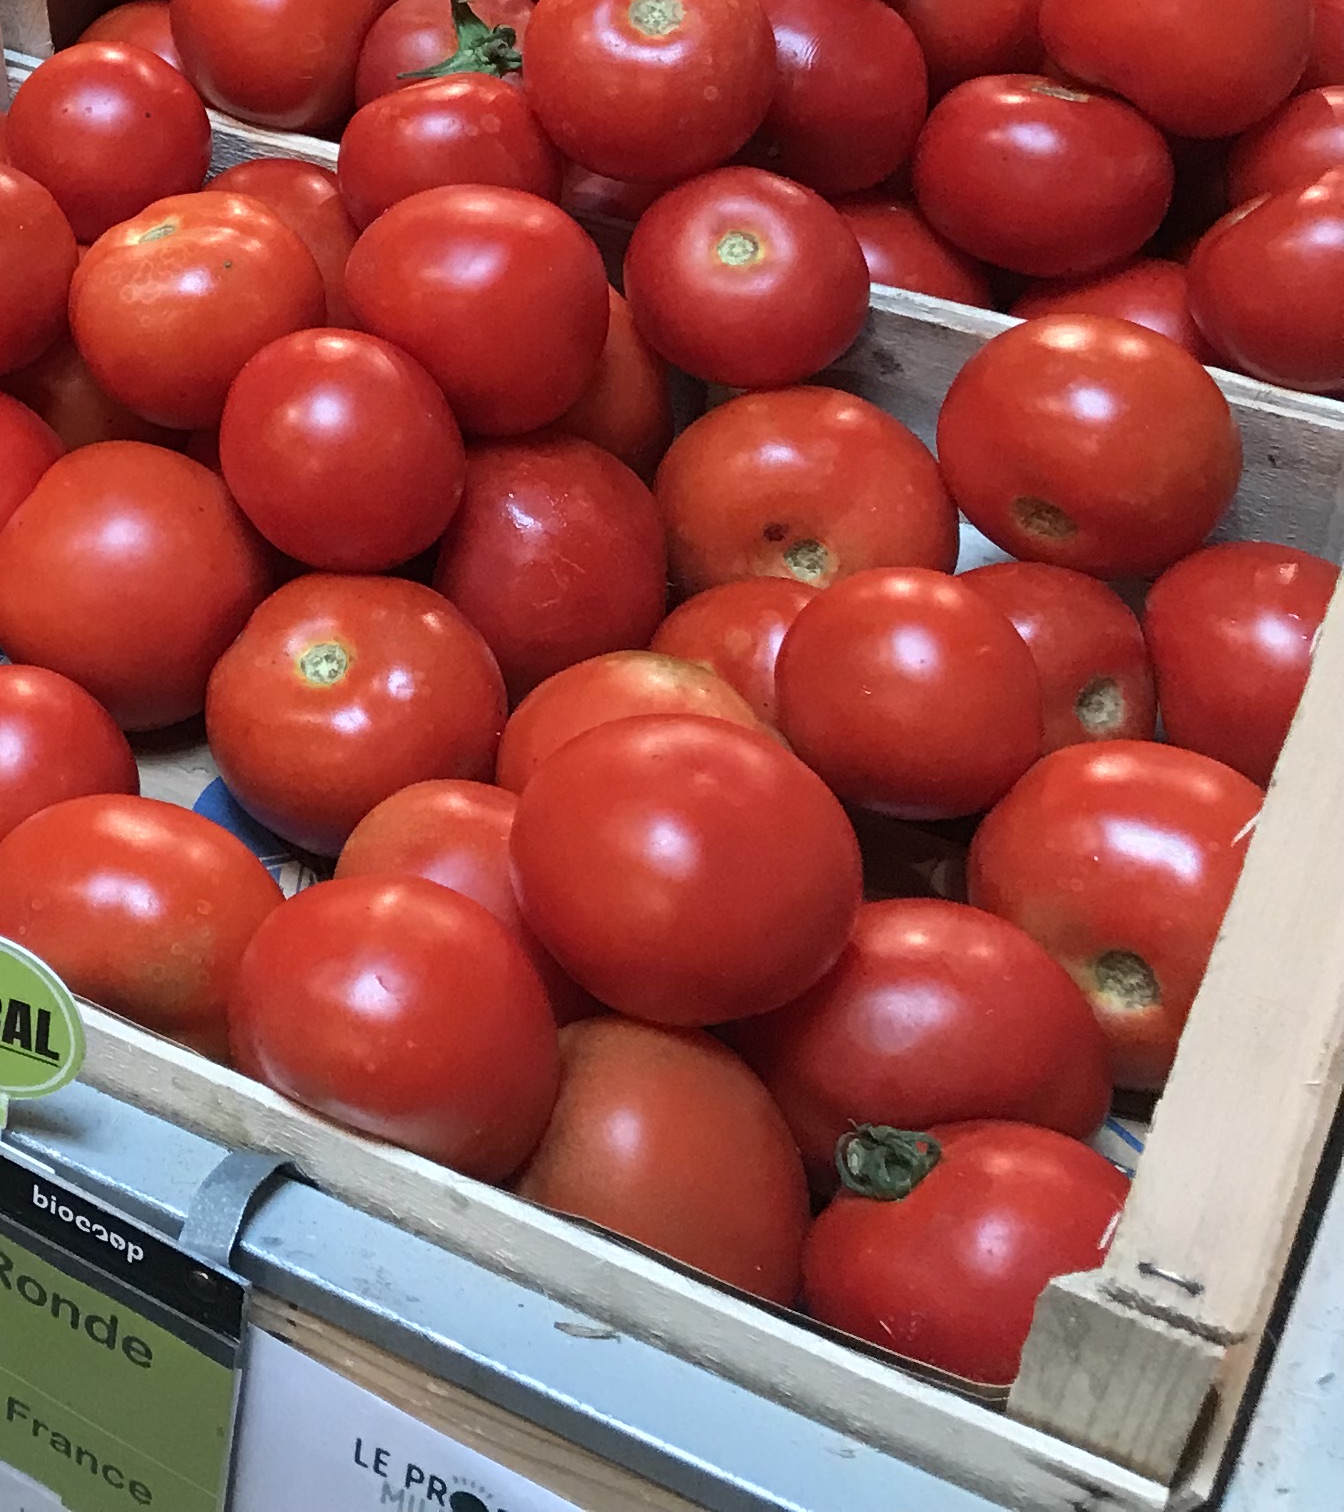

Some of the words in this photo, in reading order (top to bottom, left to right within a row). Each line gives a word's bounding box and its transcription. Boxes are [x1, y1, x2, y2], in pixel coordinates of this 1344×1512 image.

[33, 1184, 144, 1264] biocoop
[6, 1396, 153, 1506] France
[354, 1437, 391, 1478] LE
